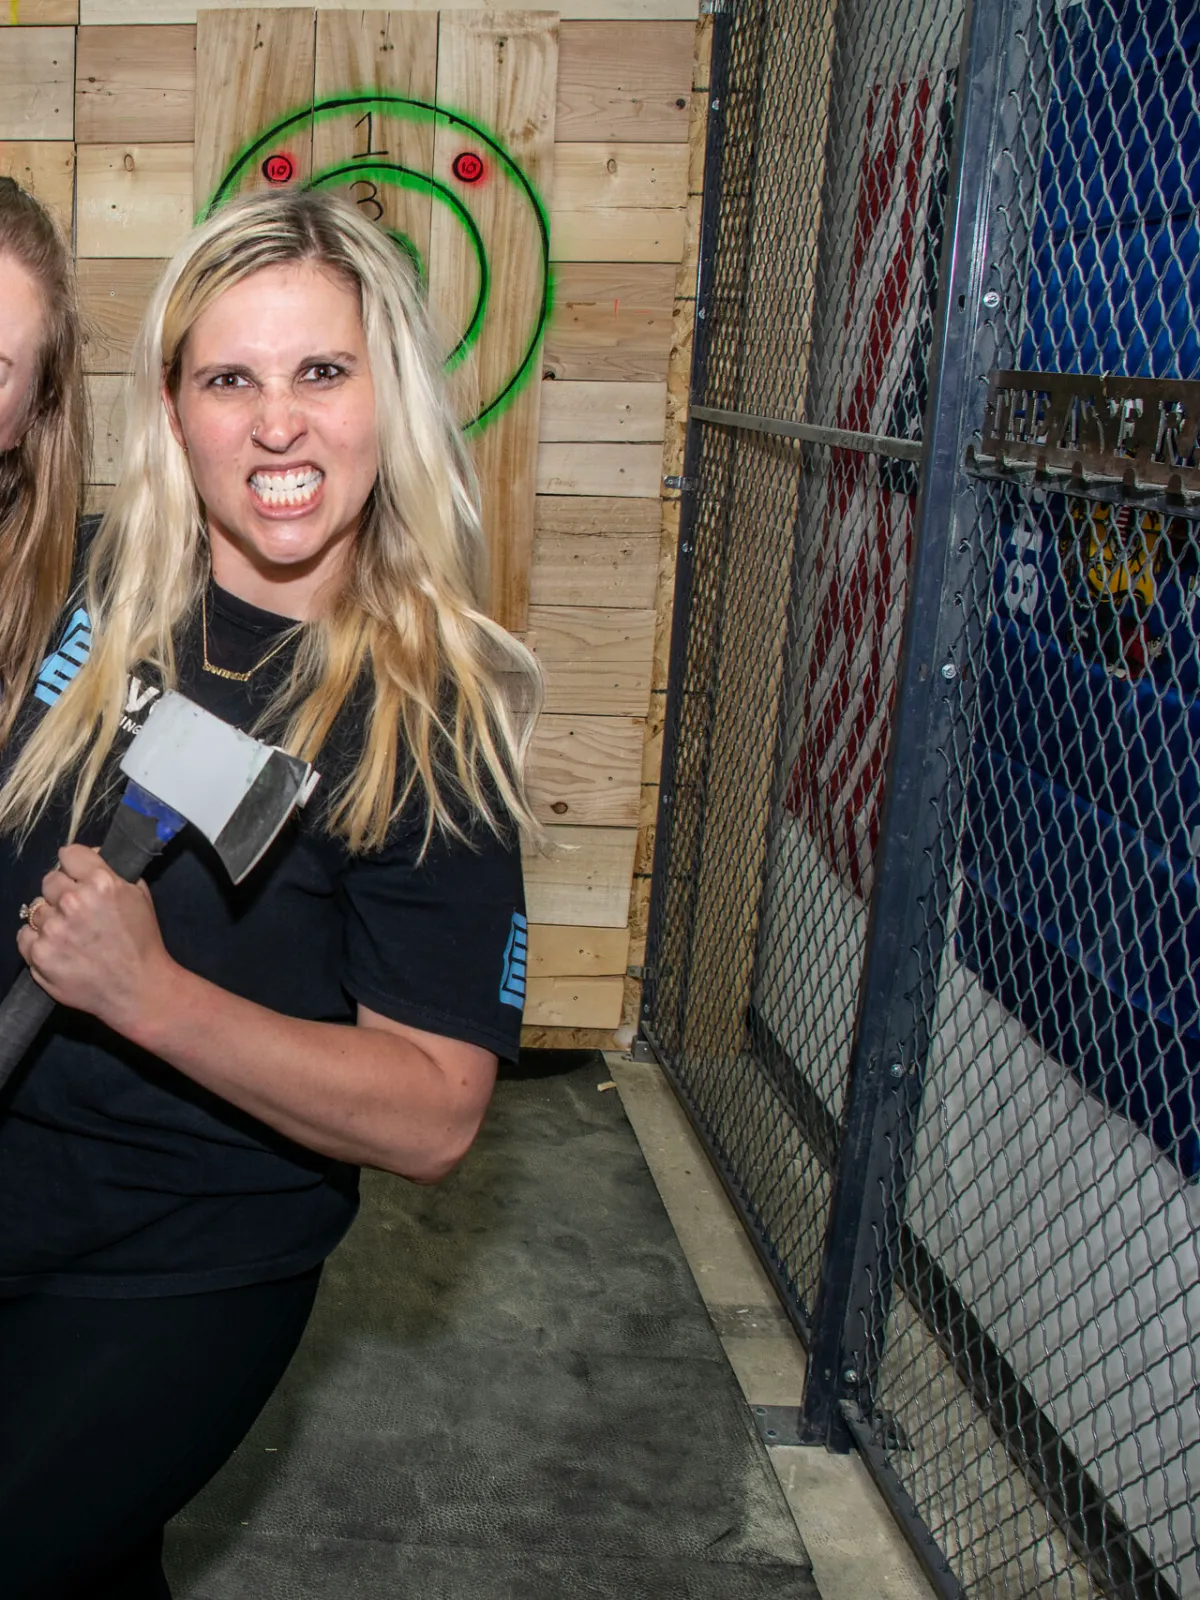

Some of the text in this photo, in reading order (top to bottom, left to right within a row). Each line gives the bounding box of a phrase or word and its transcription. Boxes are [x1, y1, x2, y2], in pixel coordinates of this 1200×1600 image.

[351, 111, 389, 159] 1
[349, 180, 384, 222] 3
[990, 387, 1052, 446] THE
